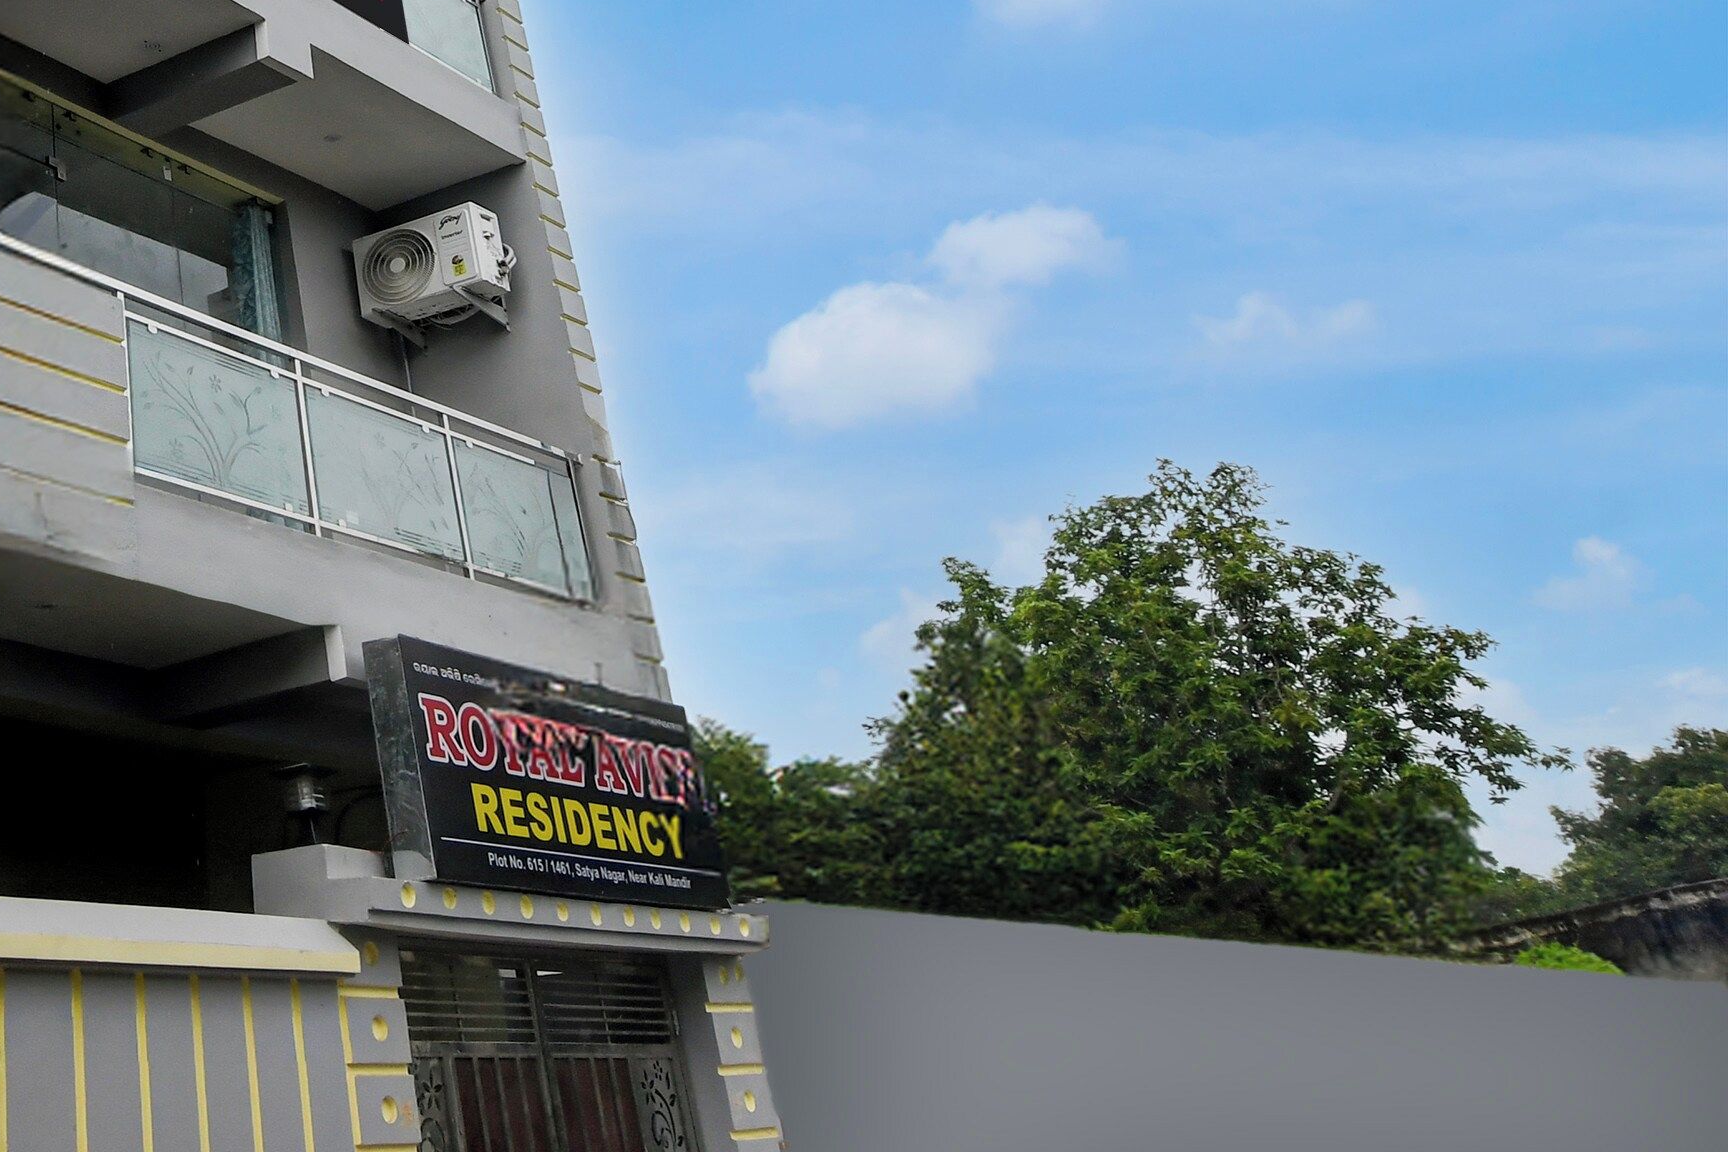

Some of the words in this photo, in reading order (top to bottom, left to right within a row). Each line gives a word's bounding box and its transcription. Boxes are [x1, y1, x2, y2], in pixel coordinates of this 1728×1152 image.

[417, 692, 585, 787] ROYAL
[470, 782, 684, 860] RESIDENCY
[487, 852, 509, 868] Plot
[509, 855, 526, 870] No.
[527, 857, 544, 872] 615
[550, 860, 575, 878] 1461,
[574, 863, 600, 882] Satya
[600, 866, 629, 884] Nagar,
[628, 869, 648, 884] Near
[647, 871, 665, 886] Kali
[664, 874, 692, 889] Mandir
